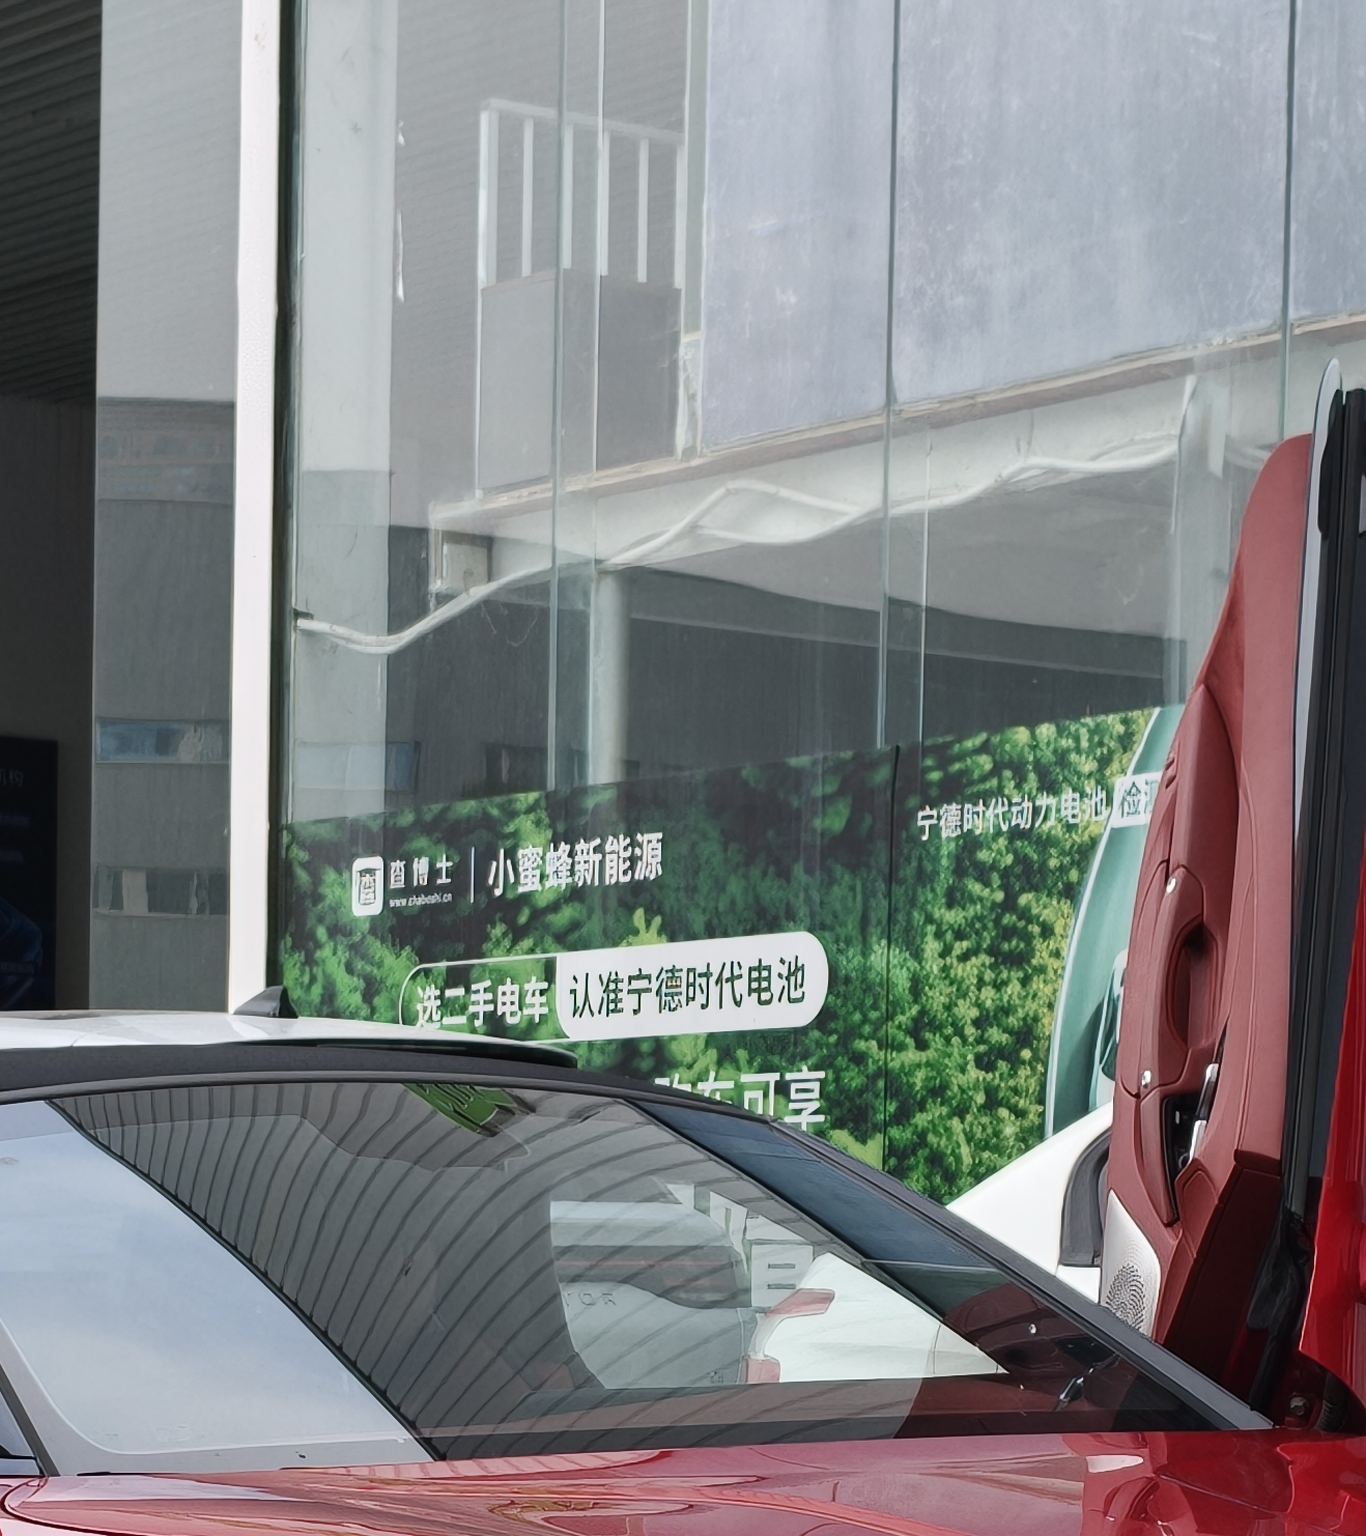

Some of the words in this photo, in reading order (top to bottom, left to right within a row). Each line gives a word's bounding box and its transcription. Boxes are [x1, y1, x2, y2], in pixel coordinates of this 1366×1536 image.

[916, 785, 1107, 841] 宁德时代动力电池
[487, 832, 664, 897] 小蜜蜂新能源
[415, 975, 549, 1029] 选二手电车
[569, 955, 806, 1019] 认准宁德时代电池
